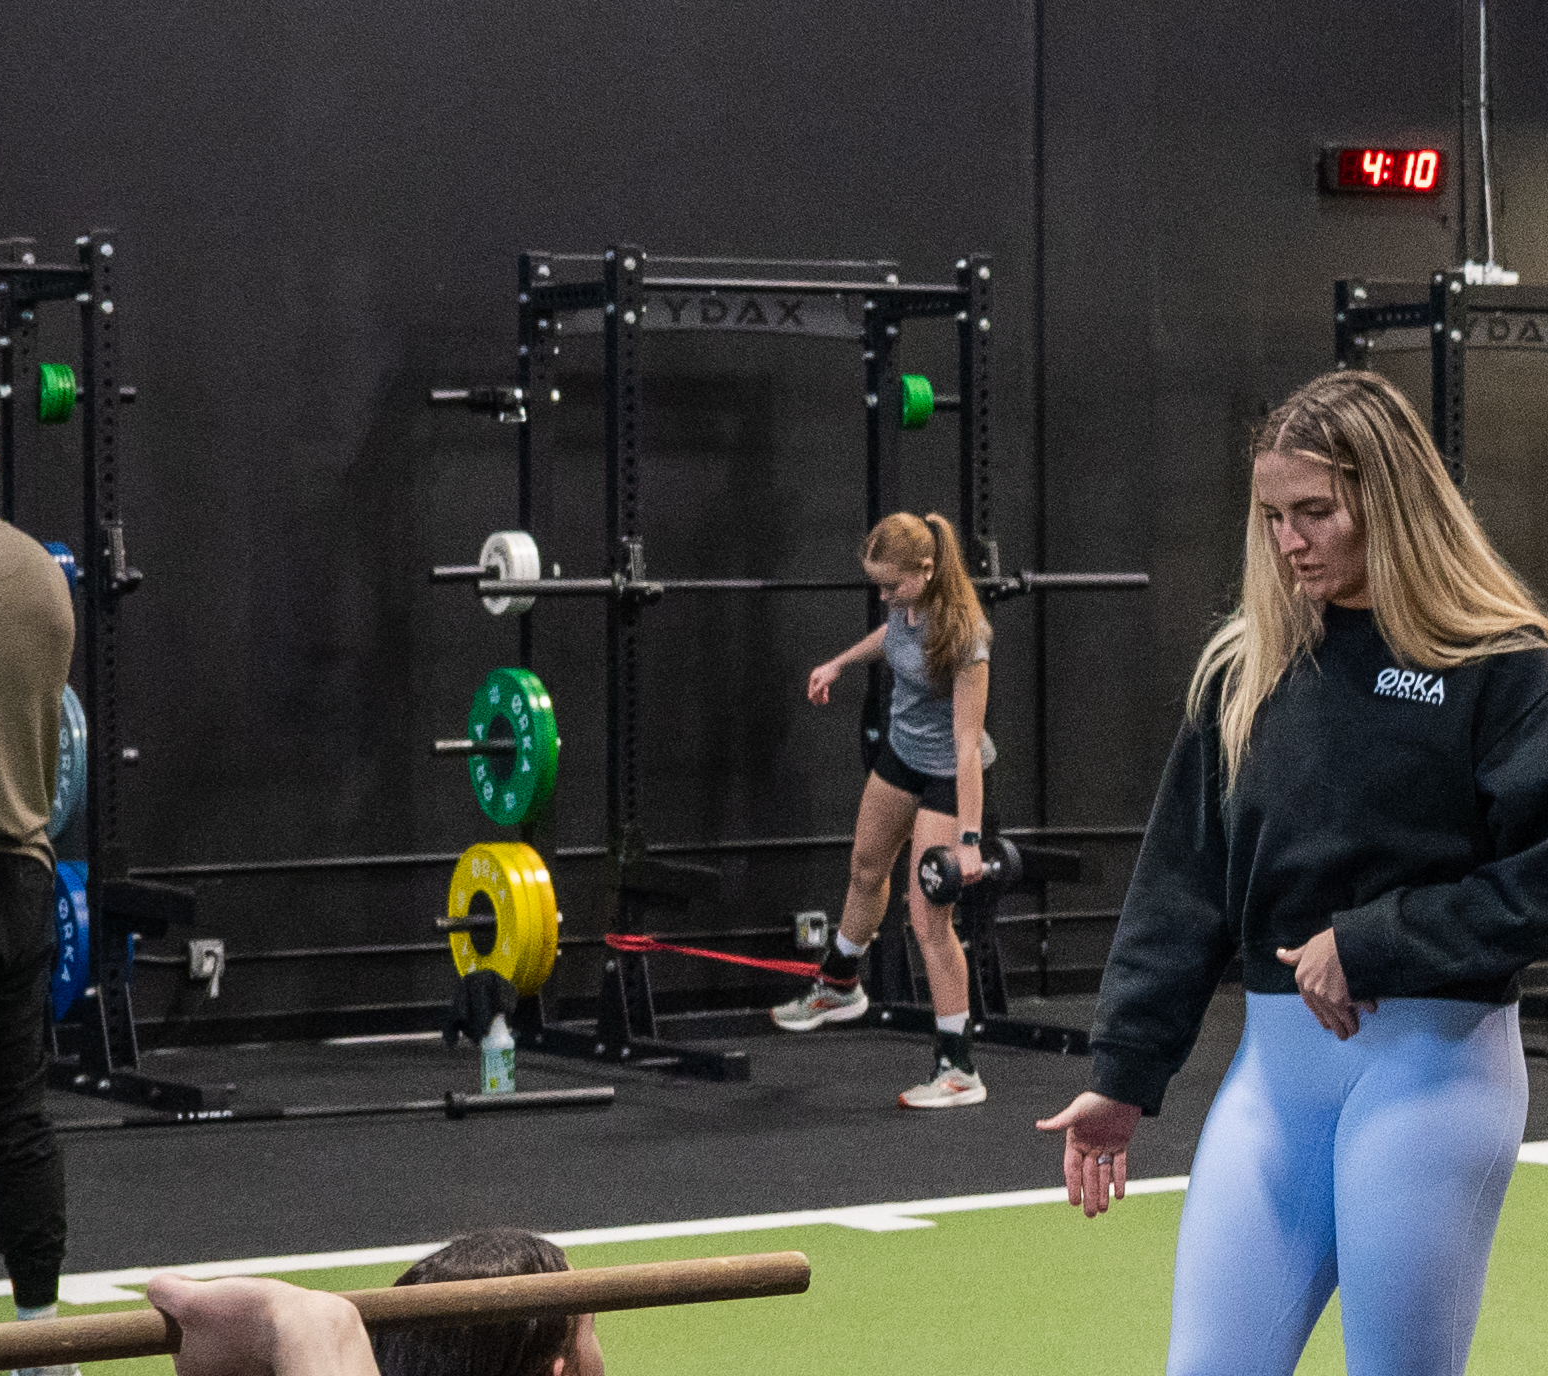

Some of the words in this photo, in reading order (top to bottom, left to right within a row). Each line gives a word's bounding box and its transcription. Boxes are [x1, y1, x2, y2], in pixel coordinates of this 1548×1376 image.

[1362, 150, 1438, 190] 4:10
[662, 295, 805, 326] YDAX
[1374, 667, 1445, 706] ØRKA
